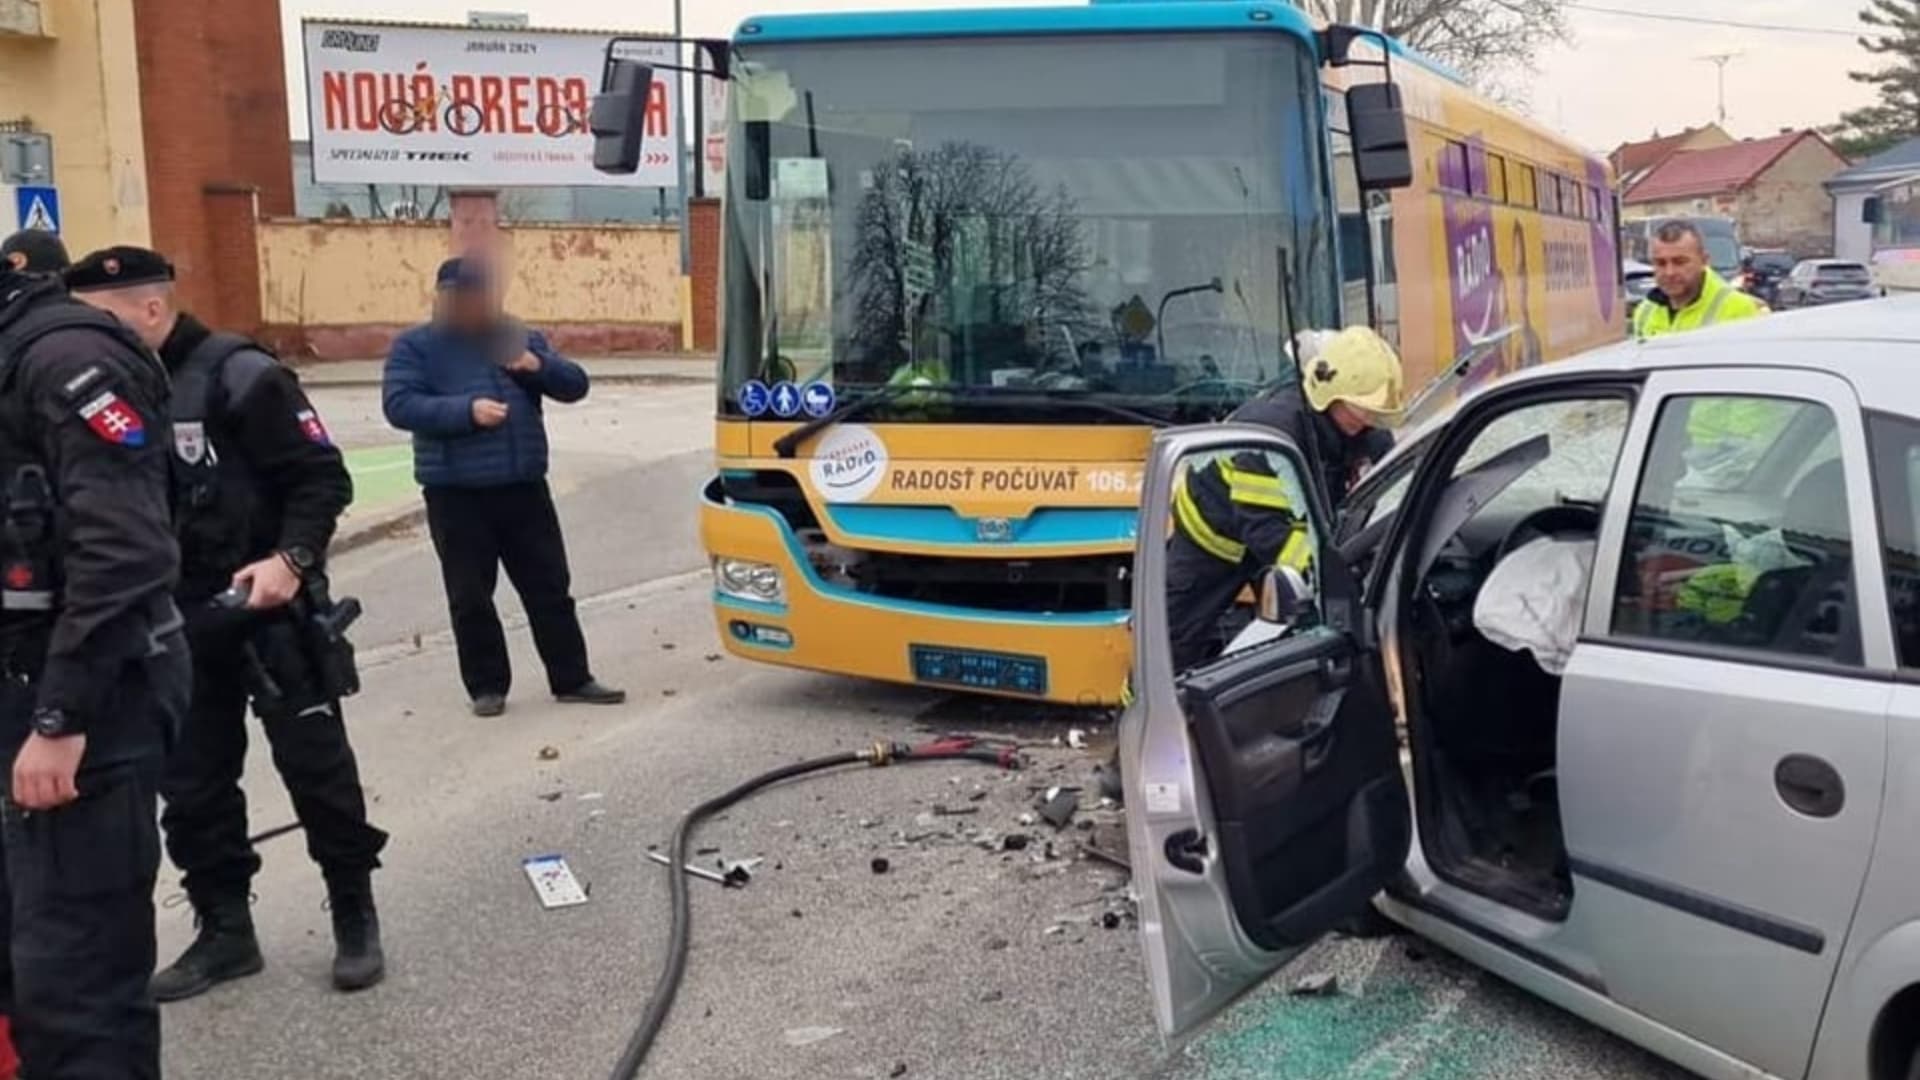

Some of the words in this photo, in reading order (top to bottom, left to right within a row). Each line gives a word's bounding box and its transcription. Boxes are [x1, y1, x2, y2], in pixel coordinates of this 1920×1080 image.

[323, 60, 438, 132] NOVÁ
[405, 151, 472, 162] TREK
[891, 467, 974, 490] RADOSŤ
[980, 466, 1080, 491] POČÚVAŤ
